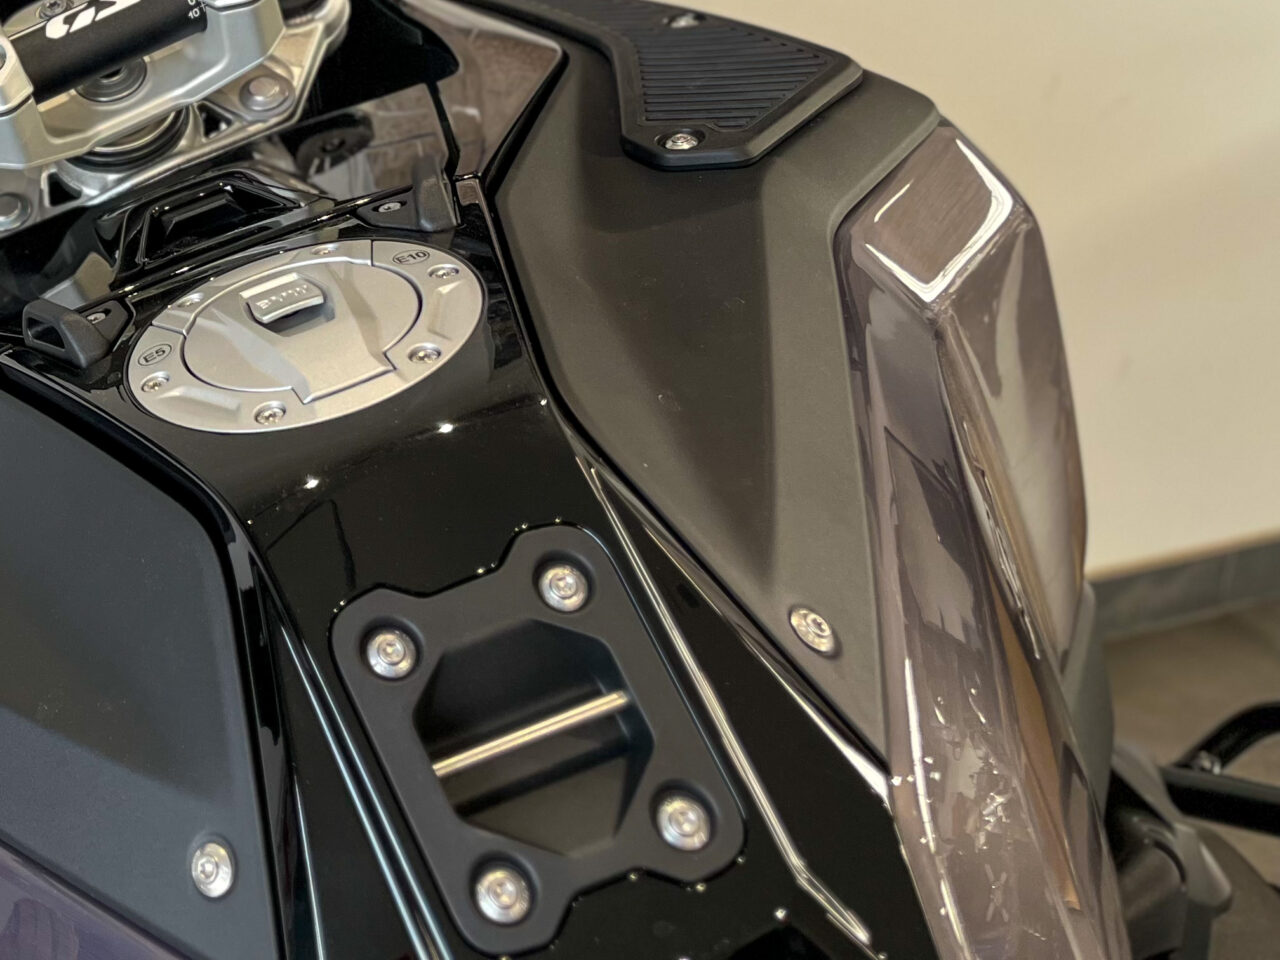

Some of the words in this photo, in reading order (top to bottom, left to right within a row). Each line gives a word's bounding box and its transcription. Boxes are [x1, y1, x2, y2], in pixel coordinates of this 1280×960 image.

[395, 251, 427, 264] E10
[256, 284, 308, 310] BMW
[143, 347, 166, 363] E5
